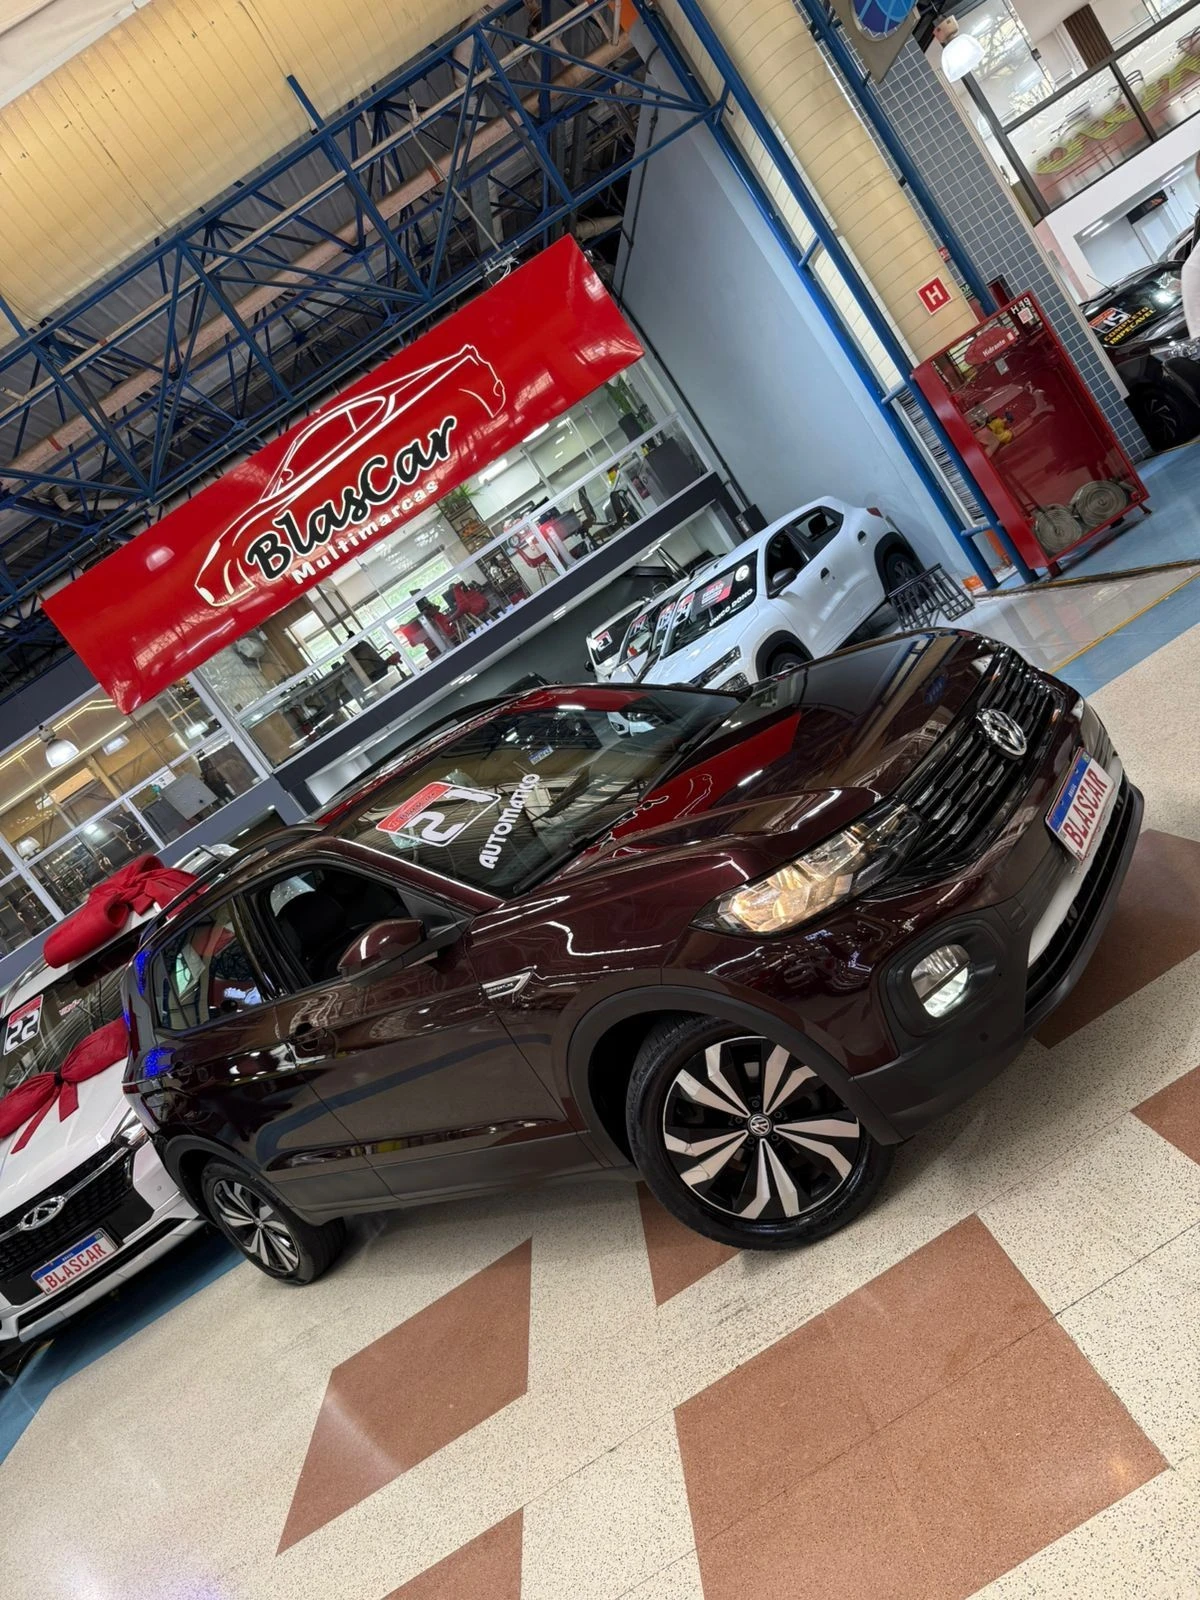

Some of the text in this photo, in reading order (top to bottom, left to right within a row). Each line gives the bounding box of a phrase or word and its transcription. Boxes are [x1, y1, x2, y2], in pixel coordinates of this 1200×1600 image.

[928, 284, 944, 306] H
[1010, 304, 1020, 315] H
[1103, 306, 1149, 342] COMPLETO
[982, 339, 1006, 357] Hidrante
[246, 414, 458, 582] BlasCar
[290, 479, 440, 586] Multimarcas
[731, 588, 754, 607] DONO
[404, 788, 494, 842] 21
[478, 773, 541, 870] AUTOMATICO
[1063, 768, 1108, 849] BLASCAR
[6, 1008, 39, 1052] 22
[44, 1243, 107, 1289] BLASCAR
